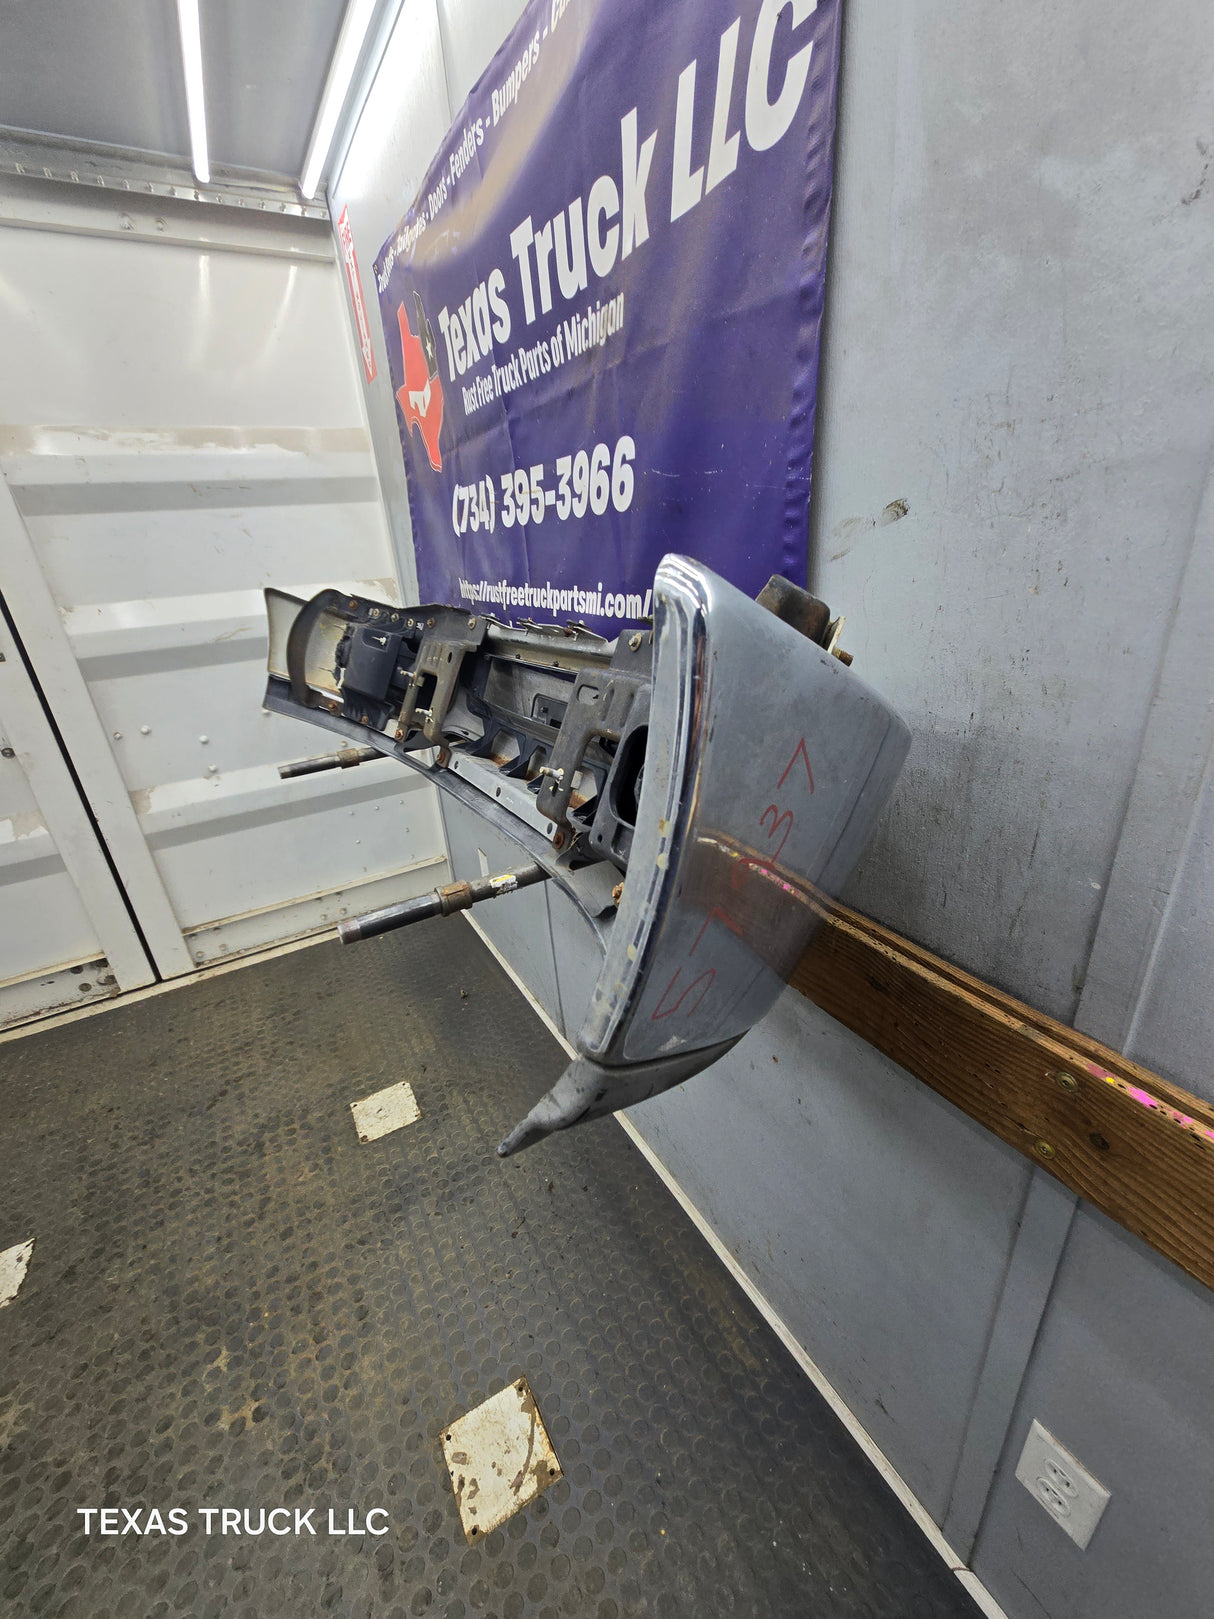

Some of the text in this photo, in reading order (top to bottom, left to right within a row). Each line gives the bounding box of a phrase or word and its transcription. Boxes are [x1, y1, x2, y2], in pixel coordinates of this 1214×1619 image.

[428, 176, 448, 221] Doors
[449, 118, 484, 186] Fenders
[492, 30, 540, 127] Bumpers
[437, 268, 511, 382] Texas
[510, 106, 659, 326] Truck
[670, 0, 817, 223] LLC
[462, 292, 625, 416] Rust Free Truck Parts of Michigan
[452, 435, 636, 537] (734) 395-3966
